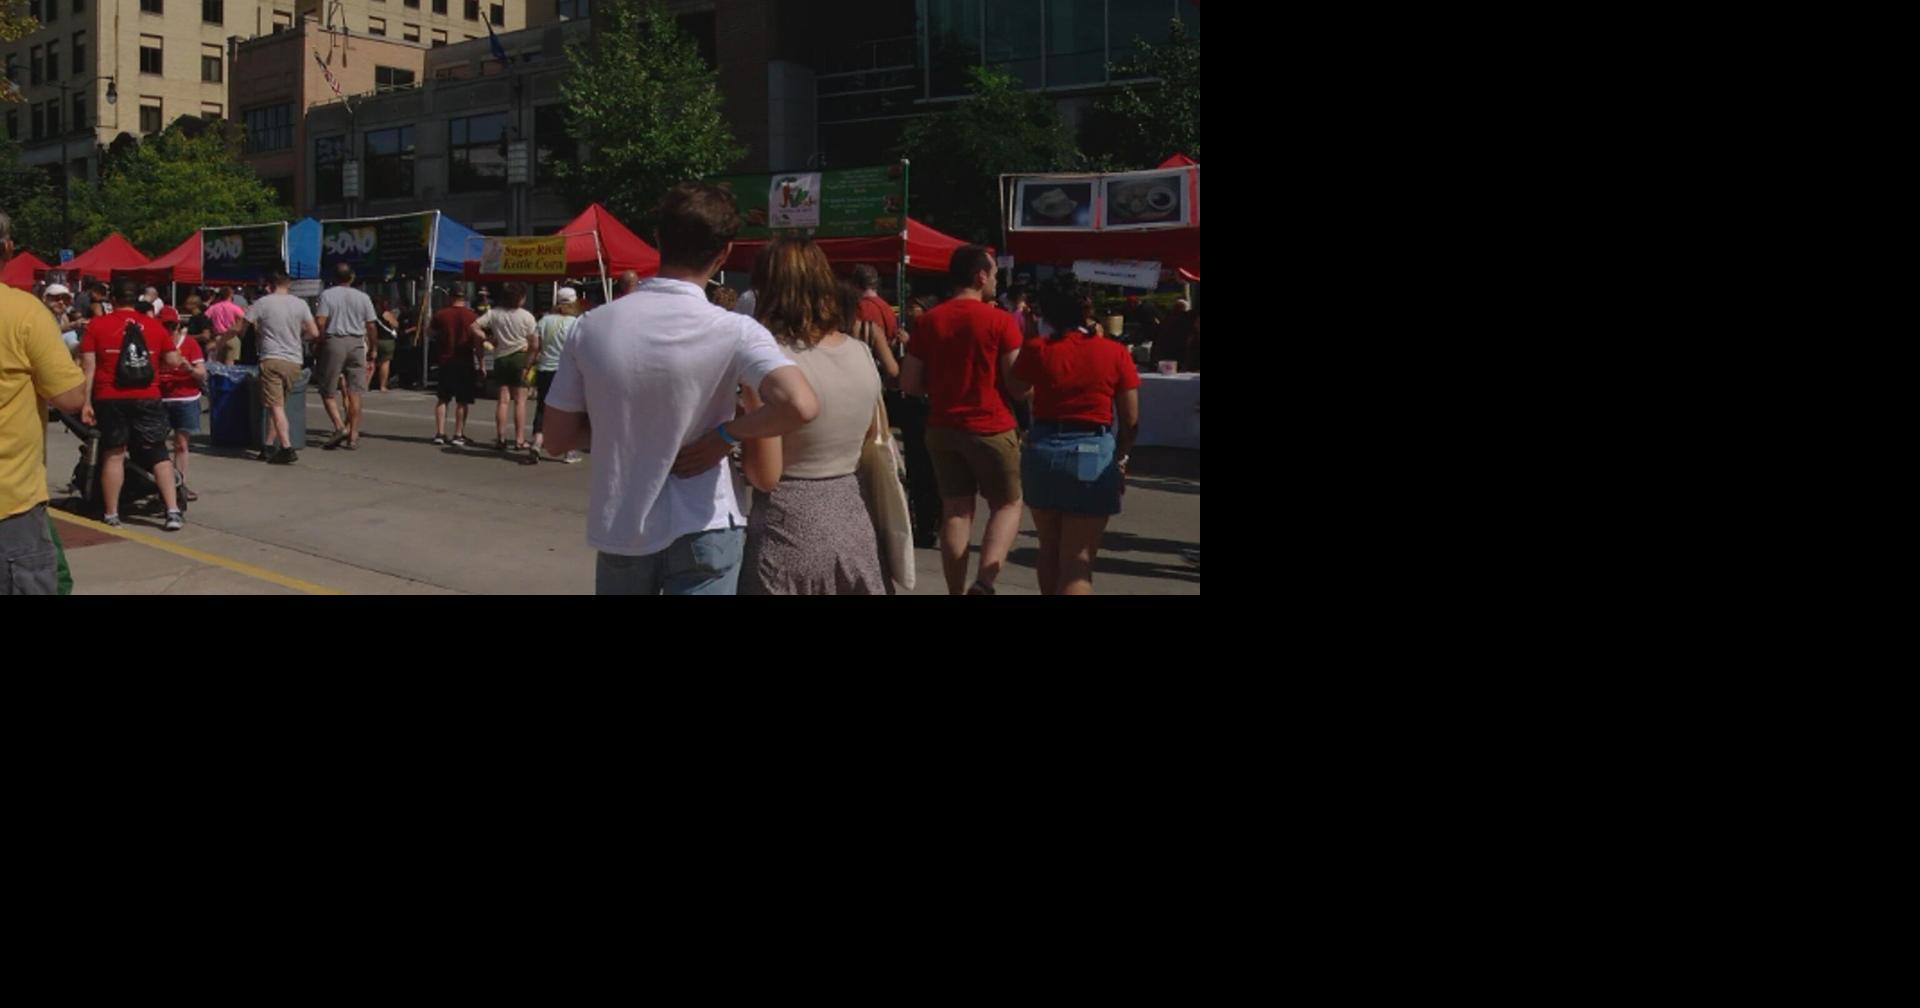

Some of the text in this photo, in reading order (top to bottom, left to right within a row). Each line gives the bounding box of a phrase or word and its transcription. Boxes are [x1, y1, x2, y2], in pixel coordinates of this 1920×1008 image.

[504, 243, 563, 257] Sugar River
[503, 257, 564, 270] Kettle Corn
